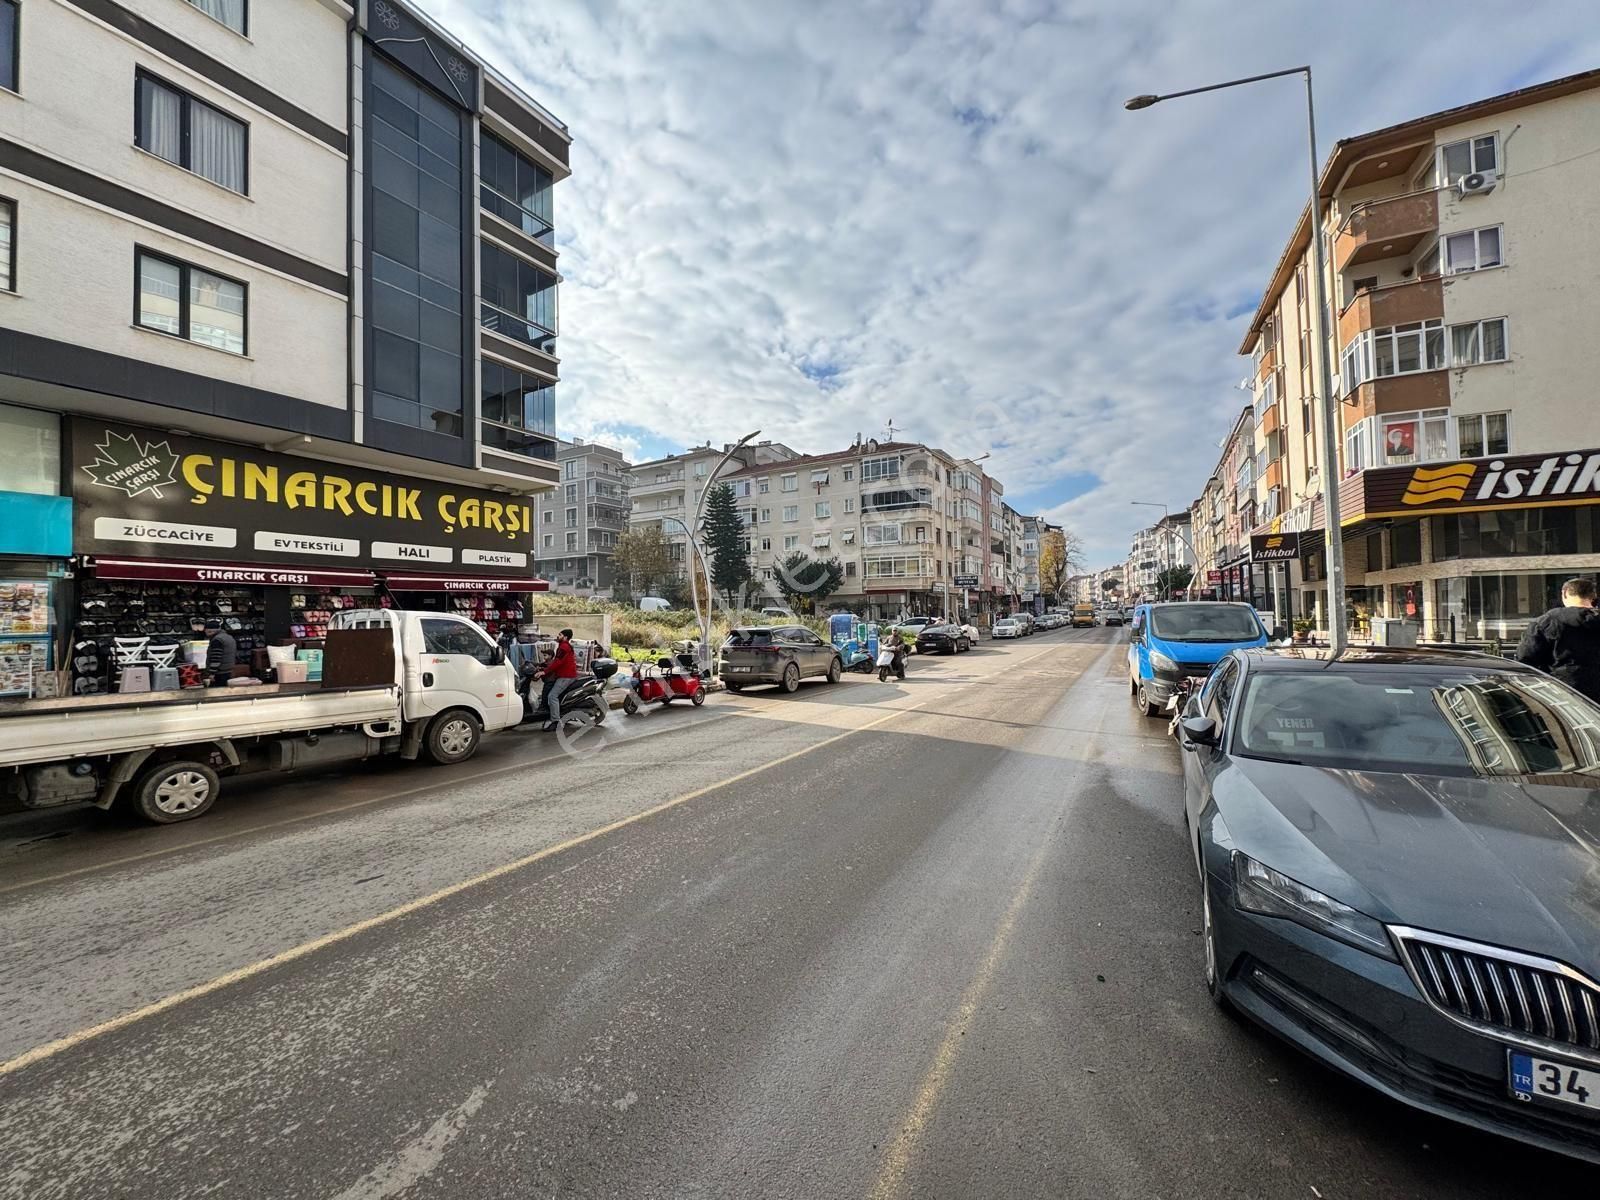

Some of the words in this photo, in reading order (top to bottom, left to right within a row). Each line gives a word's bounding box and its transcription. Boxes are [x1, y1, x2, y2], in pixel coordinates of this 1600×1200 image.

[105, 455, 160, 485] ÇINARCIK
[126, 469, 160, 490] ÇARŞI
[182, 454, 422, 521] ÇINARCIK
[438, 495, 530, 539] ÇARŞI
[123, 525, 214, 542] ZÜCCACİYE
[274, 539, 291, 548] EV
[292, 540, 344, 552] TEKSTİLİ
[398, 547, 430, 558] HALI
[479, 555, 511, 563] PLASTİK
[1255, 548, 1296, 558] istikbal
[197, 570, 266, 581] ÇINARCIK
[270, 573, 308, 584] ÇARŞI
[444, 582, 484, 590] ÇINARCIK
[1276, 718, 1315, 729] YENER
[1513, 1073, 1531, 1086] TR
[1538, 1063, 1590, 1103] 34
